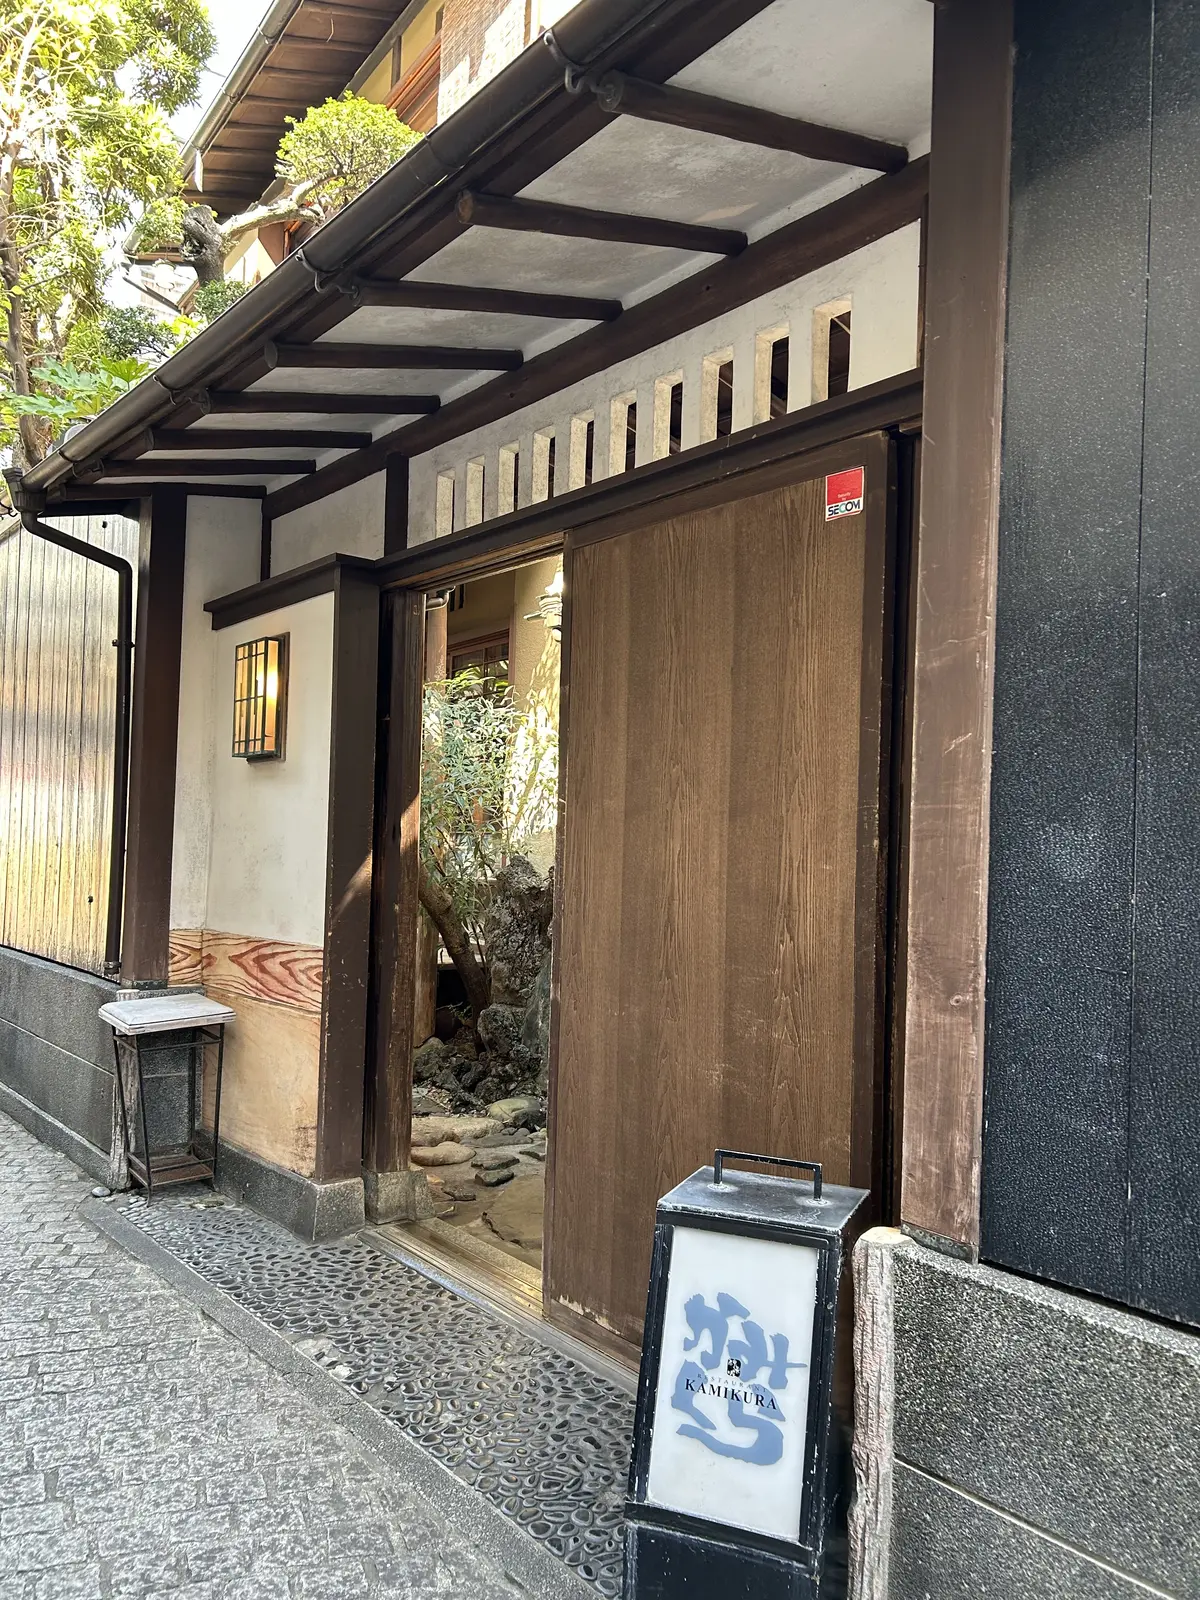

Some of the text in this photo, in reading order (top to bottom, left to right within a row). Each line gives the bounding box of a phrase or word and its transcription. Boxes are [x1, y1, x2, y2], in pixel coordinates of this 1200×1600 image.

[828, 499, 861, 517] SECOM
[697, 1373, 767, 1393] RESTAURANT
[685, 1378, 777, 1410] KAMIKURA
